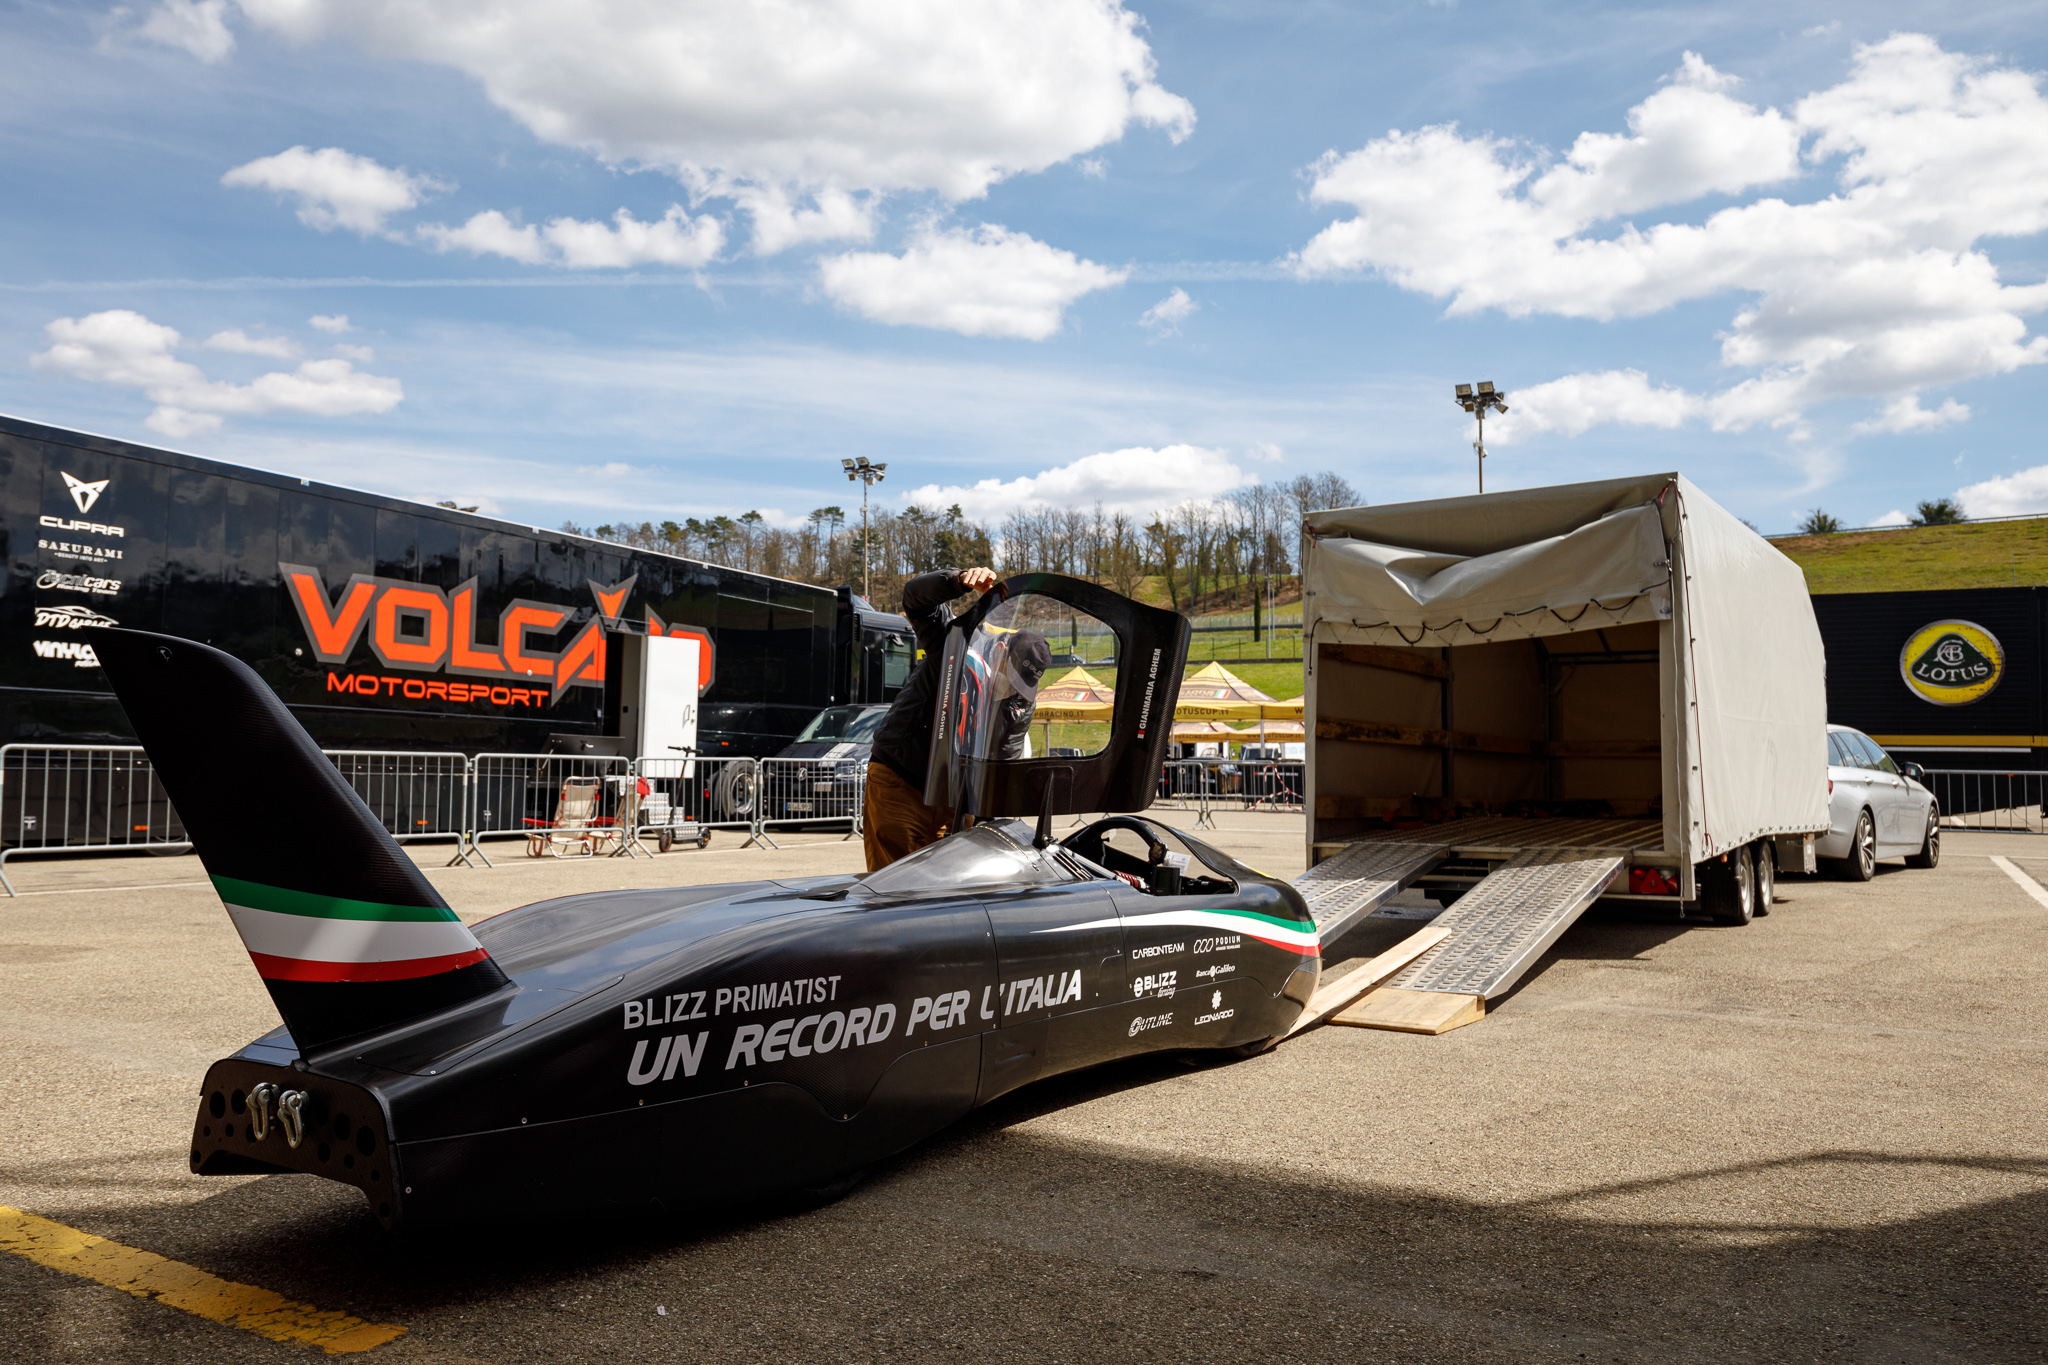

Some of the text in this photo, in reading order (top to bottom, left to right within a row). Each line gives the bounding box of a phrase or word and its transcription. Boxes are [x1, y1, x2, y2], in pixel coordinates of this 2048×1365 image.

[40, 515, 125, 538] CUPRA
[38, 539, 123, 559] SAKURAMI
[36, 569, 122, 591] Tecnicars
[56, 583, 118, 596] Racing Team
[34, 612, 71, 629] DTD
[1916, 662, 1989, 682] LOTUS
[327, 672, 549, 708] MOTORSPORT
[1139, 648, 1162, 730] GIANMARIA AGHEM
[938, 664, 954, 740] GIANMARIA AGHEM
[1132, 942, 1185, 960] CARBONTEAM
[1215, 935, 1241, 946] PODIUM
[1215, 964, 1236, 975] Galileo
[1143, 970, 1177, 991] BLIZZ
[623, 975, 842, 1030] BLIZZ PRIMATIST
[1128, 1012, 1174, 1038] OUTLINE
[1194, 1008, 1235, 1026] LEONARDO
[626, 1031, 710, 1086] UN
[725, 1003, 897, 1070] RECORD
[905, 989, 972, 1037] PER
